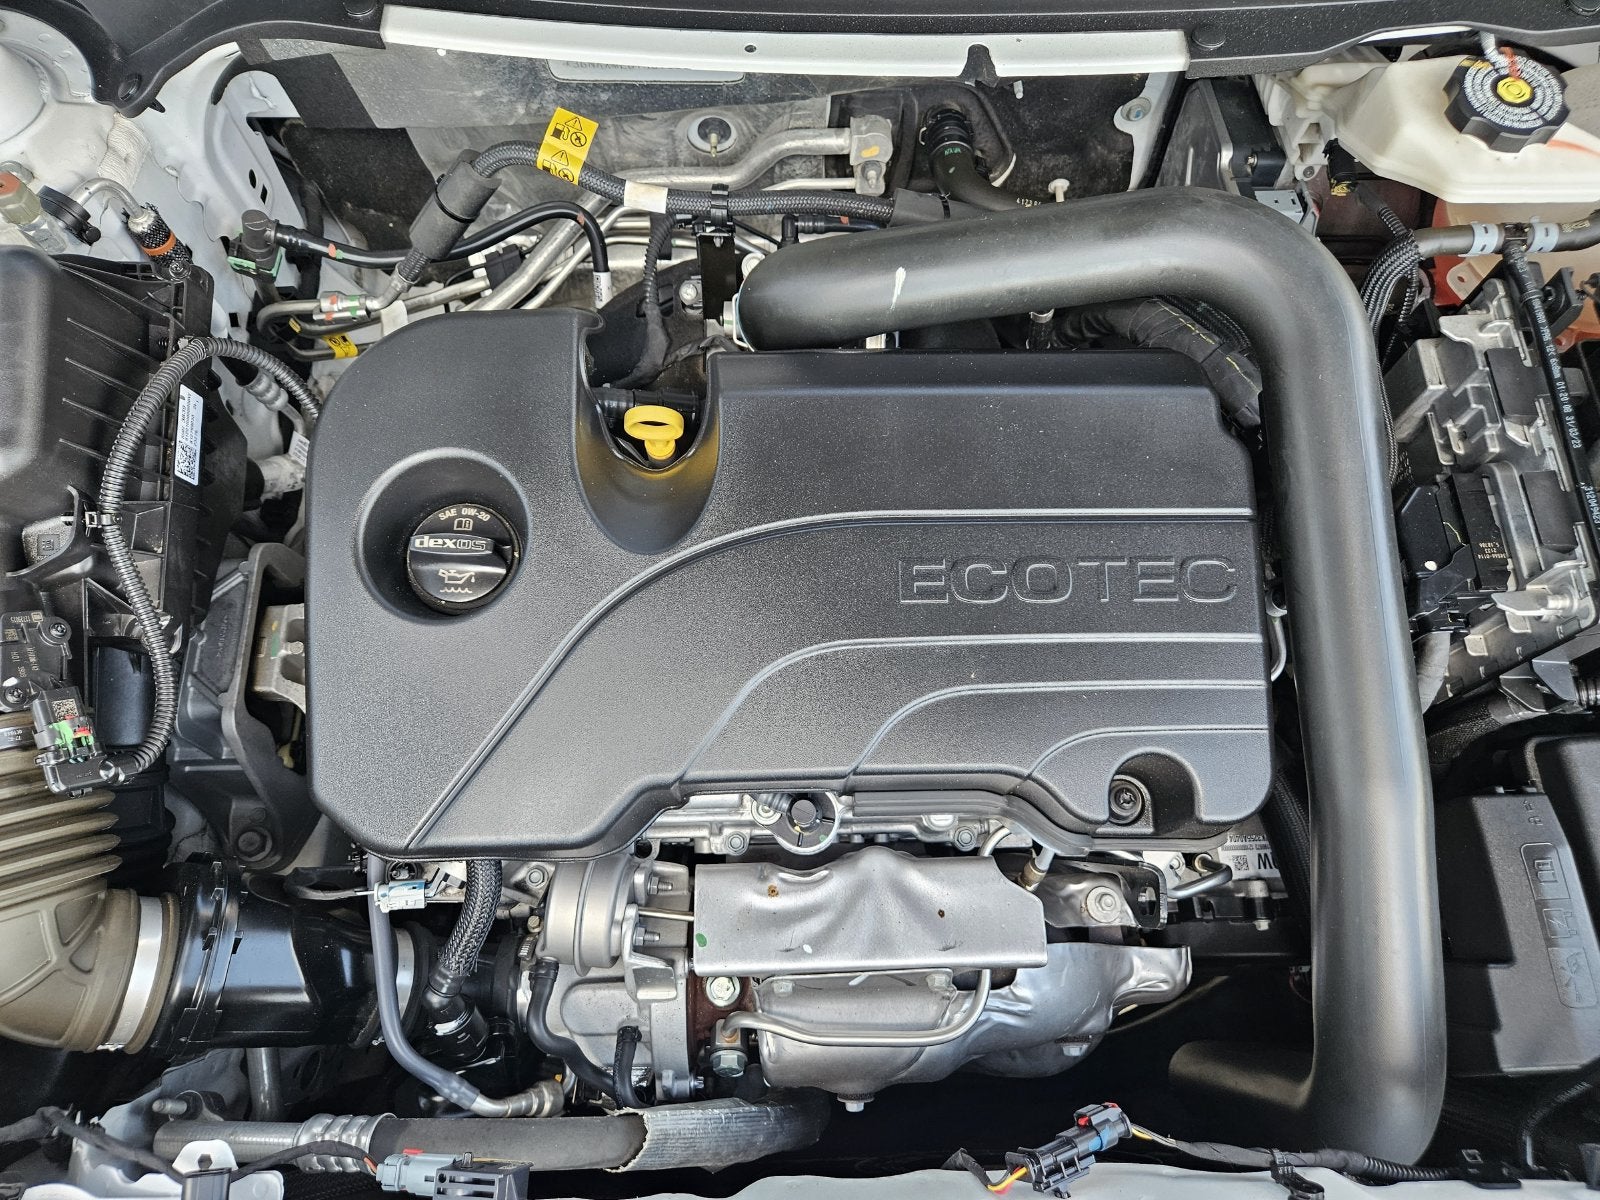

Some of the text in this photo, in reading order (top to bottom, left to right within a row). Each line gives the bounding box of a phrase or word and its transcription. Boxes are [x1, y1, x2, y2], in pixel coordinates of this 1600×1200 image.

[438, 507, 491, 522] SAE 0W-20
[414, 535, 487, 551] dexos
[899, 556, 1238, 604] ECOTEC
